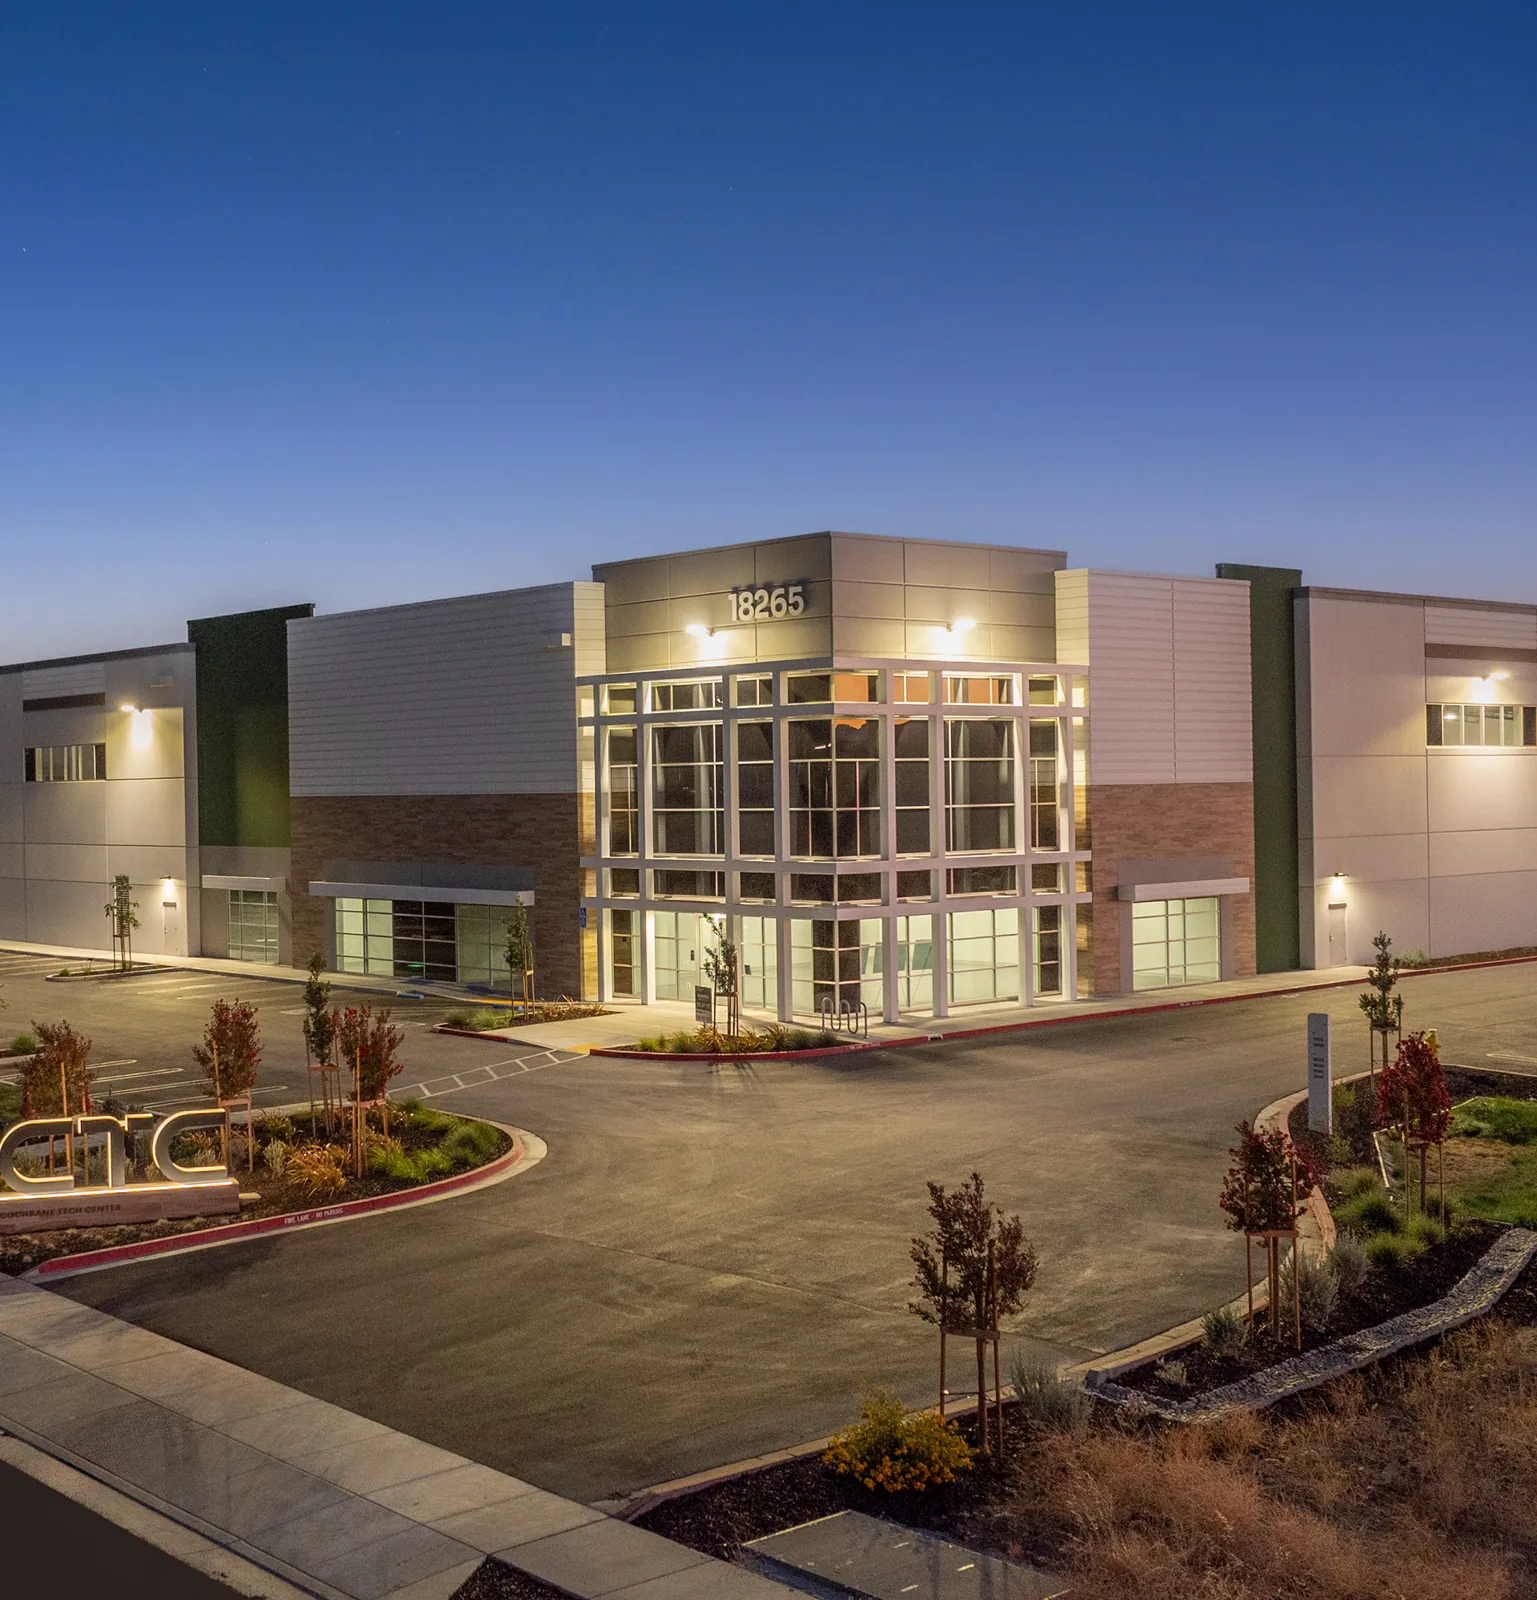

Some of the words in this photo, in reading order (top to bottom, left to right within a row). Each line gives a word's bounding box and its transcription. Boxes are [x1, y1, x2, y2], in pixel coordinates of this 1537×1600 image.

[728, 585, 805, 622] 18265
[0, 1208, 54, 1219] COCHRANE
[58, 1206, 82, 1216] TECH
[84, 1203, 121, 1214] CENTER
[284, 1216, 296, 1224] FIRE
[297, 1213, 310, 1221] LANE
[324, 1207, 344, 1216] PARKING
